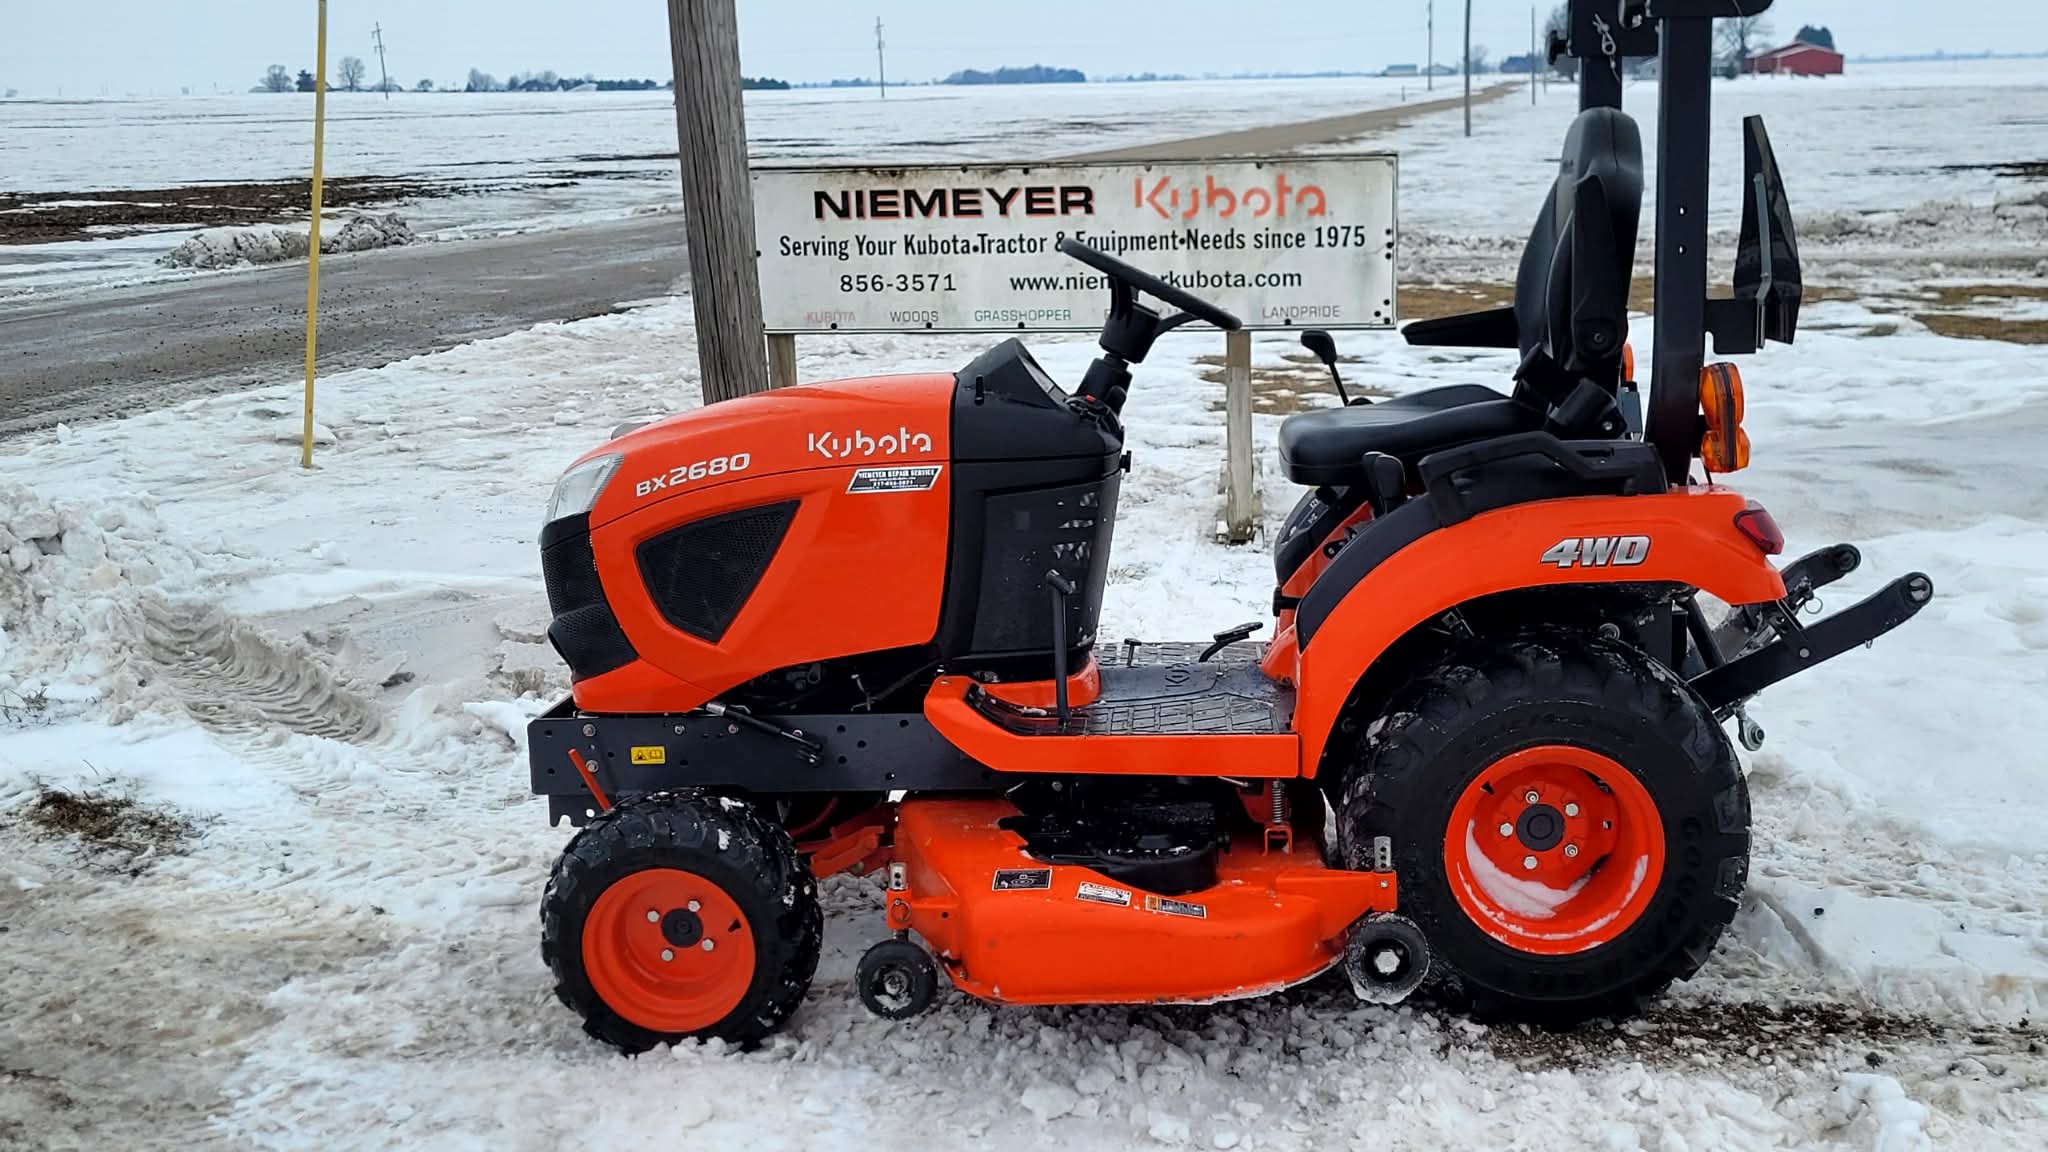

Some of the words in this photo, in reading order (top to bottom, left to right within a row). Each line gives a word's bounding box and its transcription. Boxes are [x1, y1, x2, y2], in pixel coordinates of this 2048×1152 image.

[813, 186, 1095, 220] NIEMEYER
[1134, 173, 1326, 219] Kubota
[779, 235, 849, 260] Serving
[856, 235, 896, 256] Your
[904, 234, 971, 255] Kubota
[977, 233, 1047, 253] Tractor
[1055, 231, 1066, 252] &
[1076, 230, 1179, 256] Equipment
[1186, 228, 1245, 250] Needs
[1254, 227, 1306, 248] since
[1314, 226, 1365, 248] 1975
[840, 273, 957, 293] 856-3571
[1010, 270, 1302, 291] www.nierkubota.com
[805, 311, 856, 324] KUBOTA
[890, 311, 939, 323] WOODS
[974, 309, 1071, 322] GRASSHOPPER
[1262, 305, 1340, 319] LANDPRIDE
[808, 427, 931, 458] Kubota
[635, 453, 750, 497] BX2680
[888, 470, 910, 478] REPAIR
[911, 469, 935, 477] SERVICE
[1540, 535, 1652, 568] 4WD
